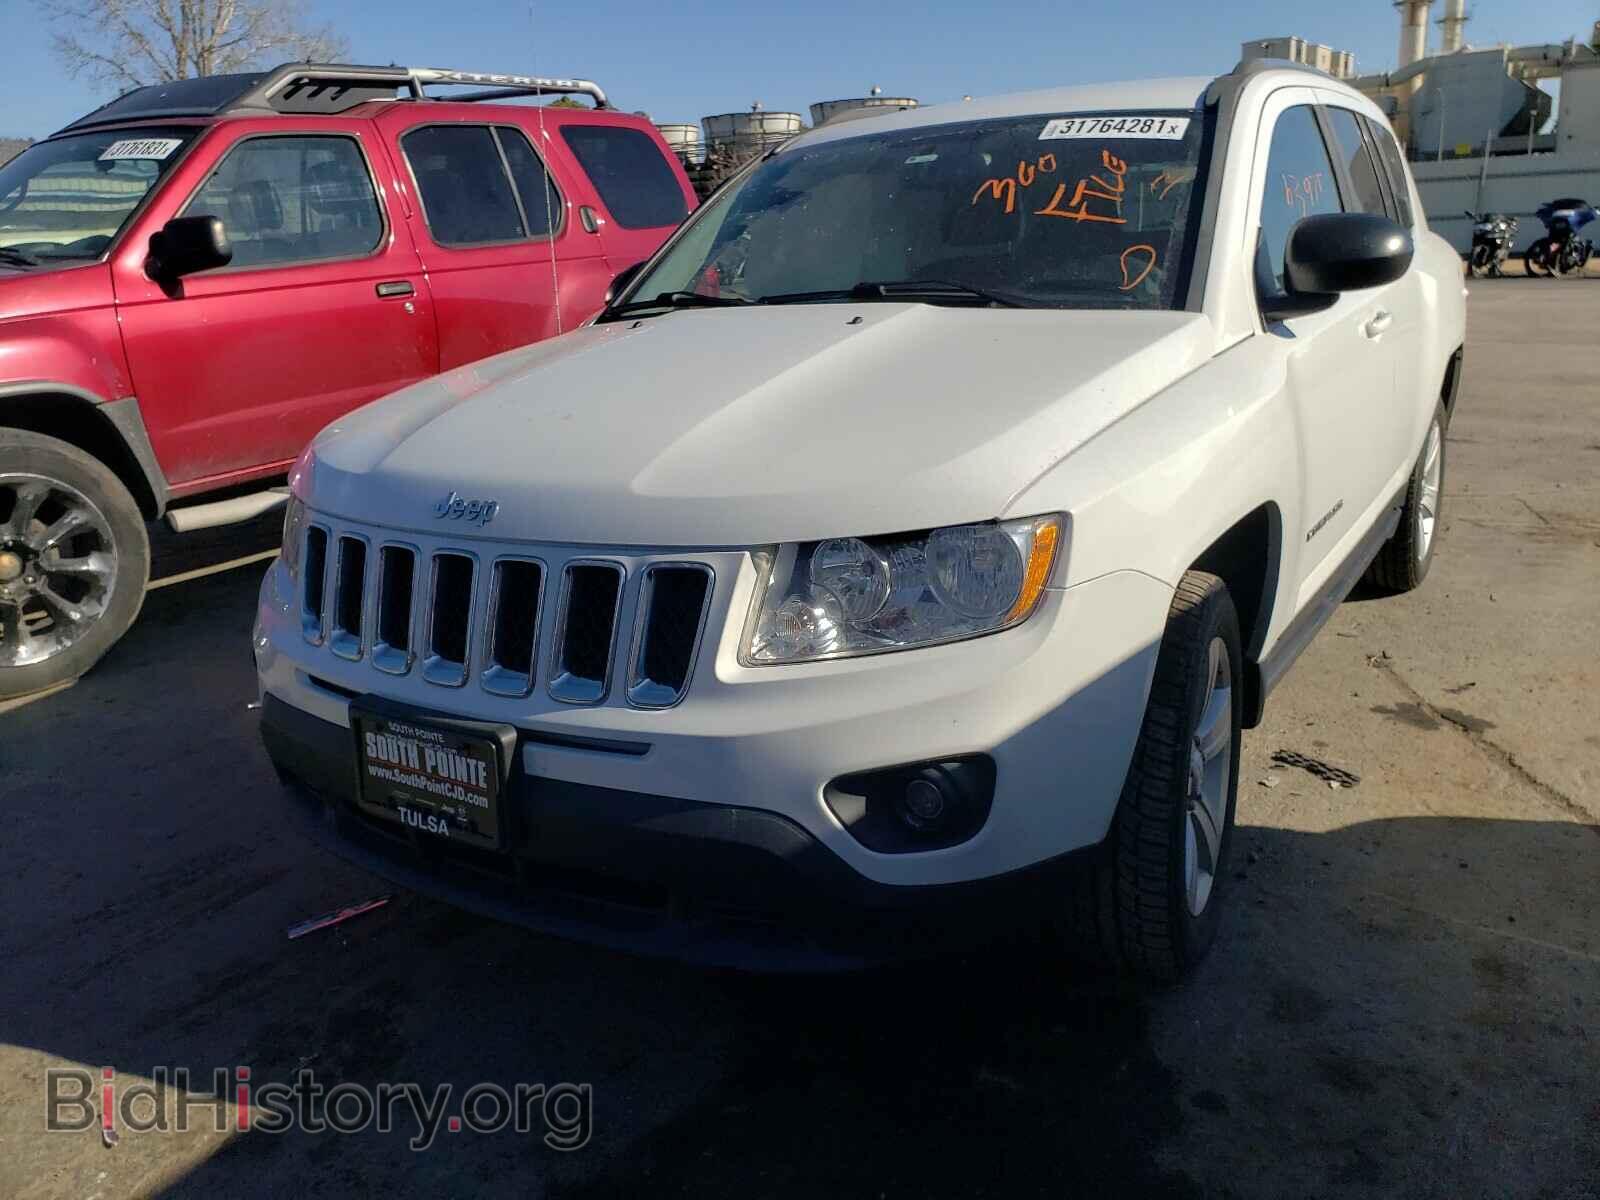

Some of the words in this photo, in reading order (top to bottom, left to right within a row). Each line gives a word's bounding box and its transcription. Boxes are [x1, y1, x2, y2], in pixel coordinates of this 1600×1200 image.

[431, 491, 500, 527] Jeep
[389, 721, 415, 736] SOUTH
[415, 727, 446, 743] POINTE
[365, 732, 420, 770] SOUTH
[424, 748, 488, 788] POINTE
[398, 806, 449, 836] TULSA
